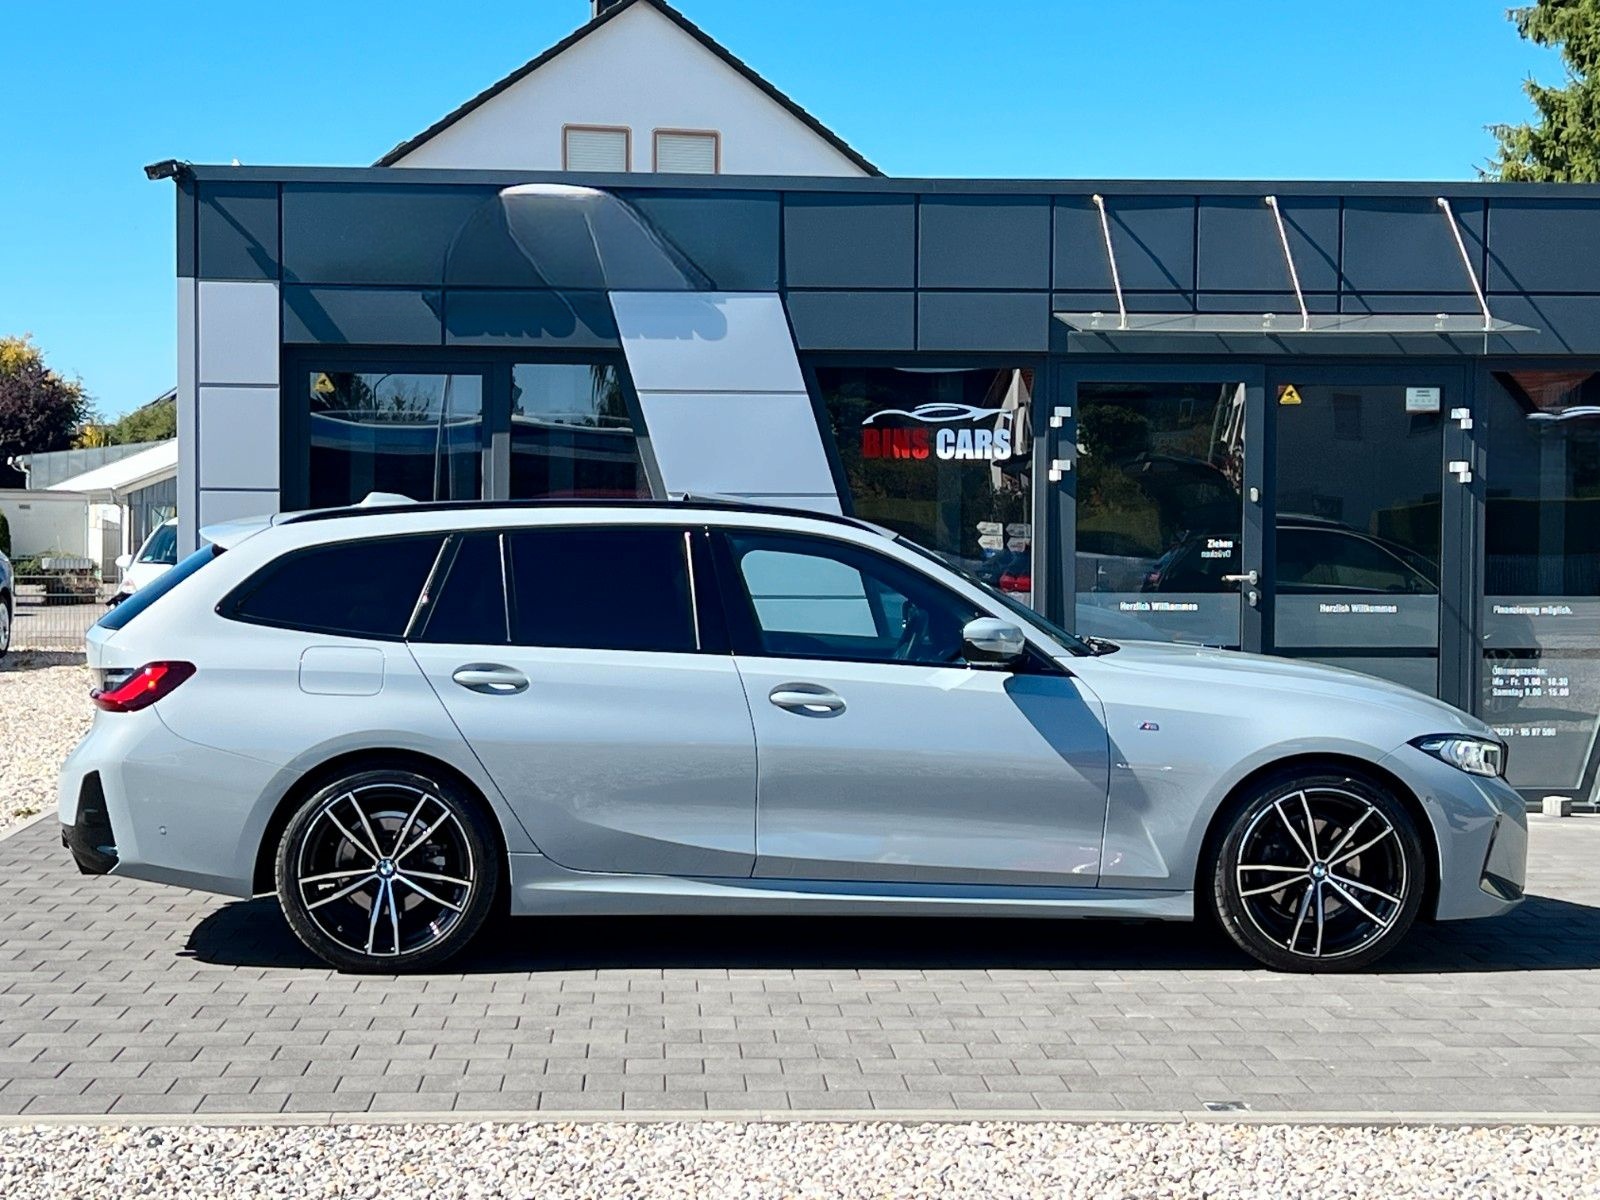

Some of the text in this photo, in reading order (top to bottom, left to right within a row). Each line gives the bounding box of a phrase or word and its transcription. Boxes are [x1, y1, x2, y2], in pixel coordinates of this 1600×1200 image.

[862, 428, 1012, 460] BINS CARS
[1207, 539, 1233, 548] Ziehen
[1120, 601, 1198, 611] Herzlich Willkommen
[1319, 603, 1397, 613] Herzlich Willkommen
[1493, 605, 1540, 615] Finanzierung
[1492, 687, 1524, 698] Samstag
